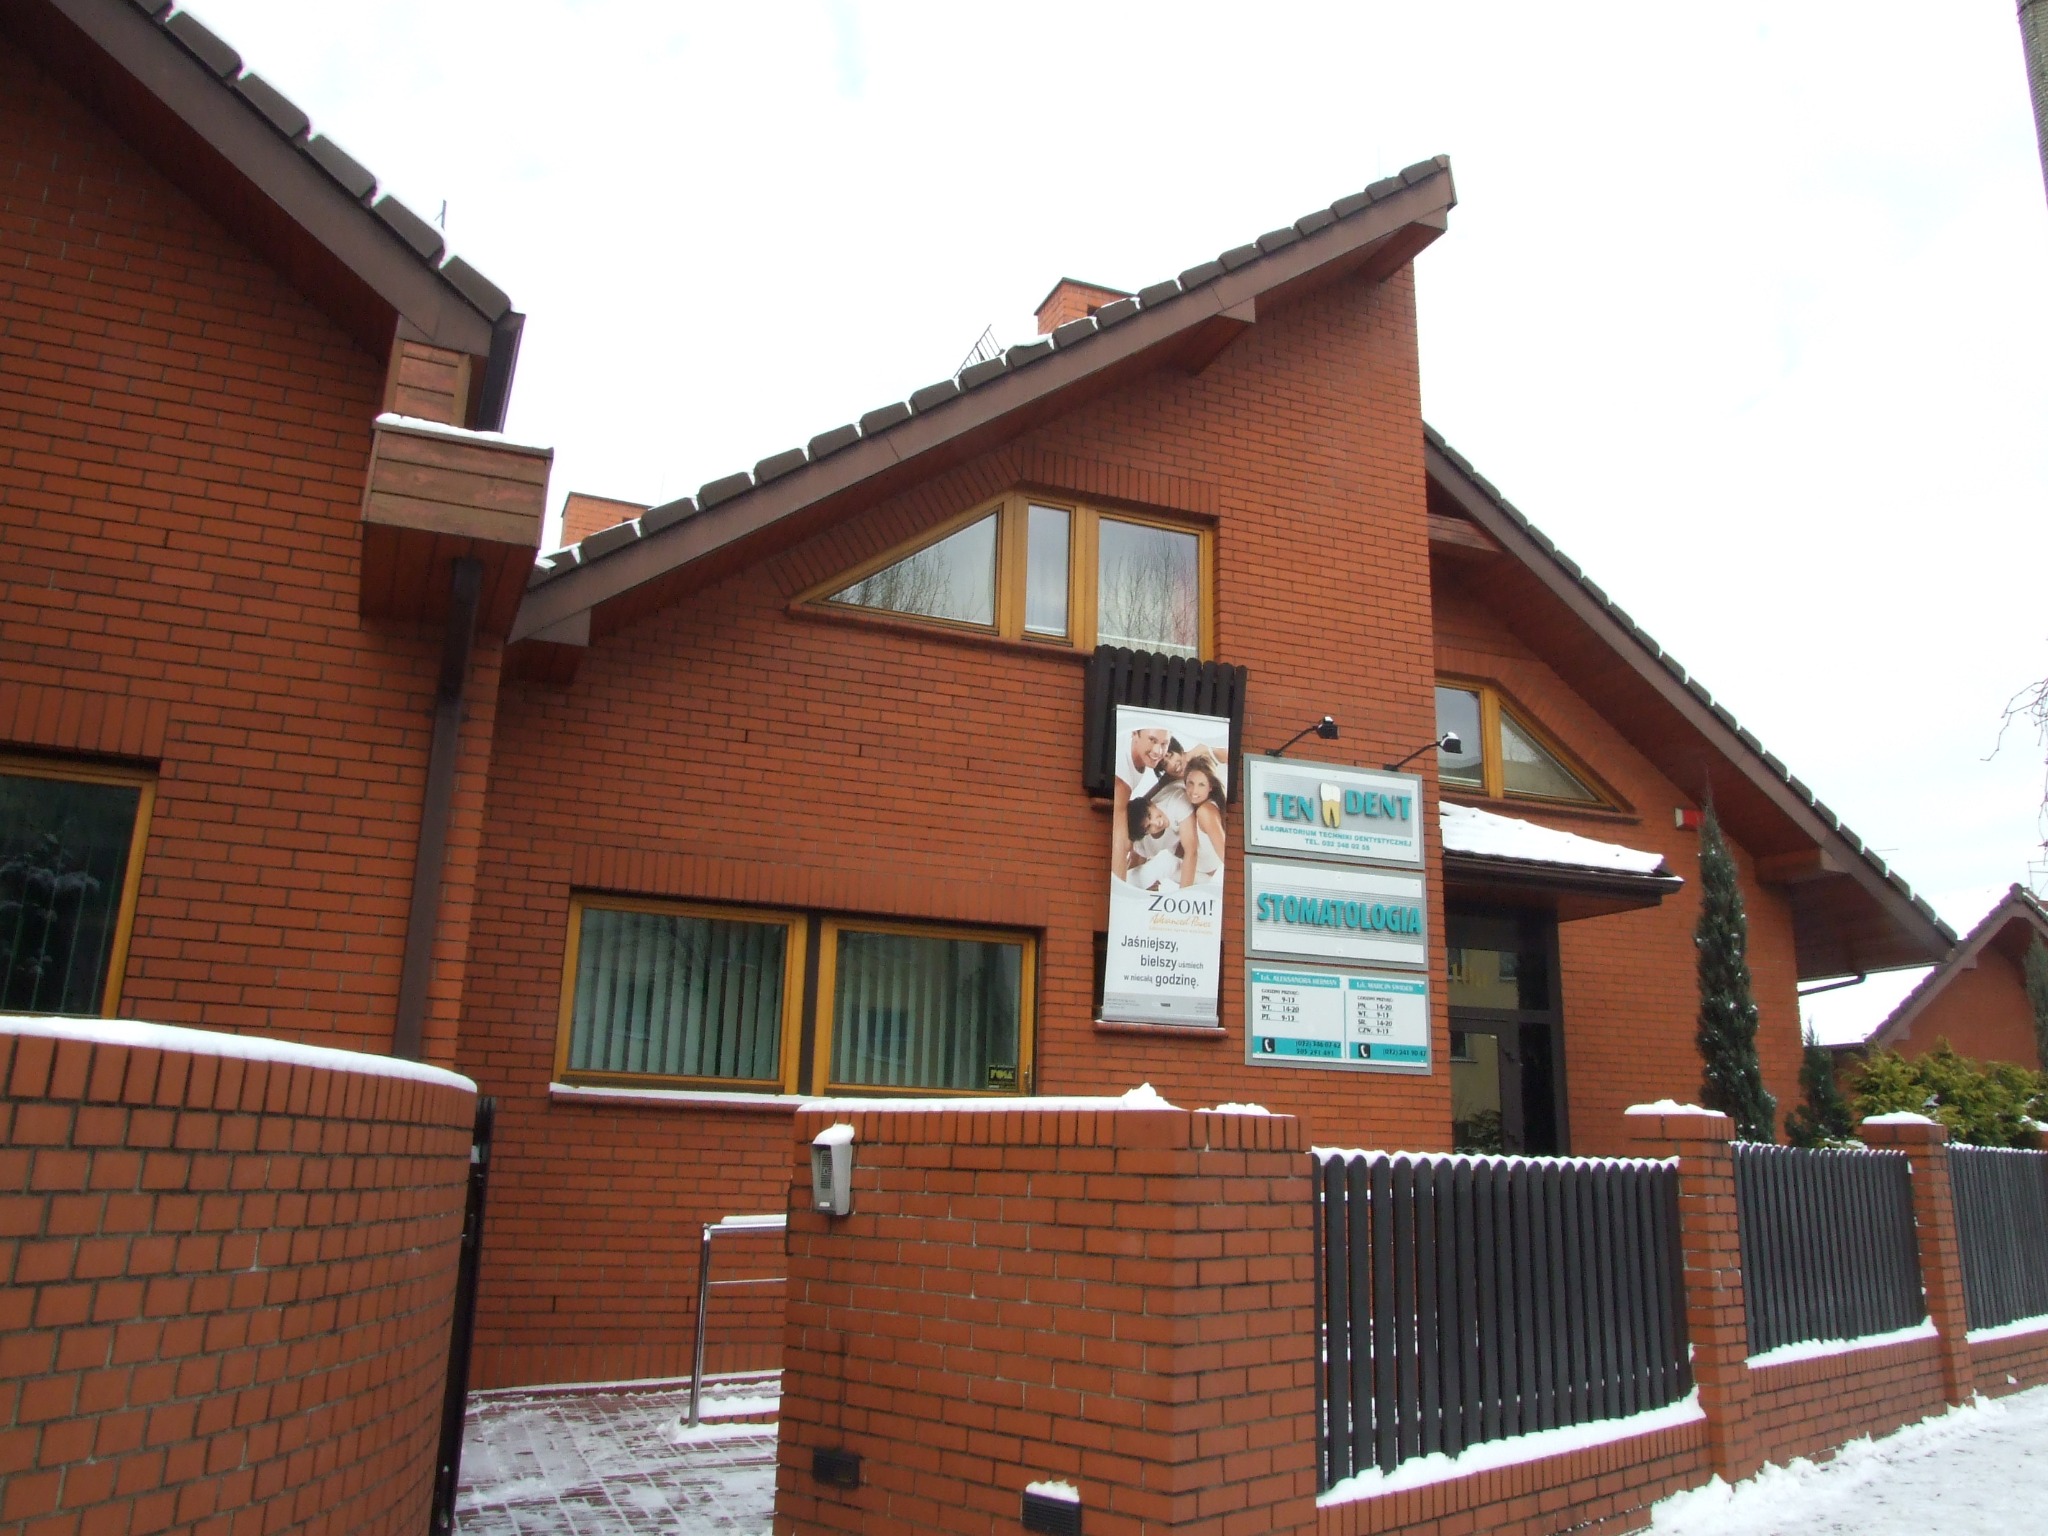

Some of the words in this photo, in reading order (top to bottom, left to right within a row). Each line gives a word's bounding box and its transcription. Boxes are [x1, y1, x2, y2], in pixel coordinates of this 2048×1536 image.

[1264, 792, 1314, 822] TEN
[1345, 790, 1412, 820] DENT
[1260, 824, 1316, 836] LABORATORIUM
[1148, 894, 1214, 916] ZOOM!
[1257, 892, 1422, 934] STOMATOLOGIA
[1121, 934, 1179, 952] Jaśniejszy,
[1140, 955, 1178, 970] bielszy
[1156, 974, 1199, 989] godzinę.
